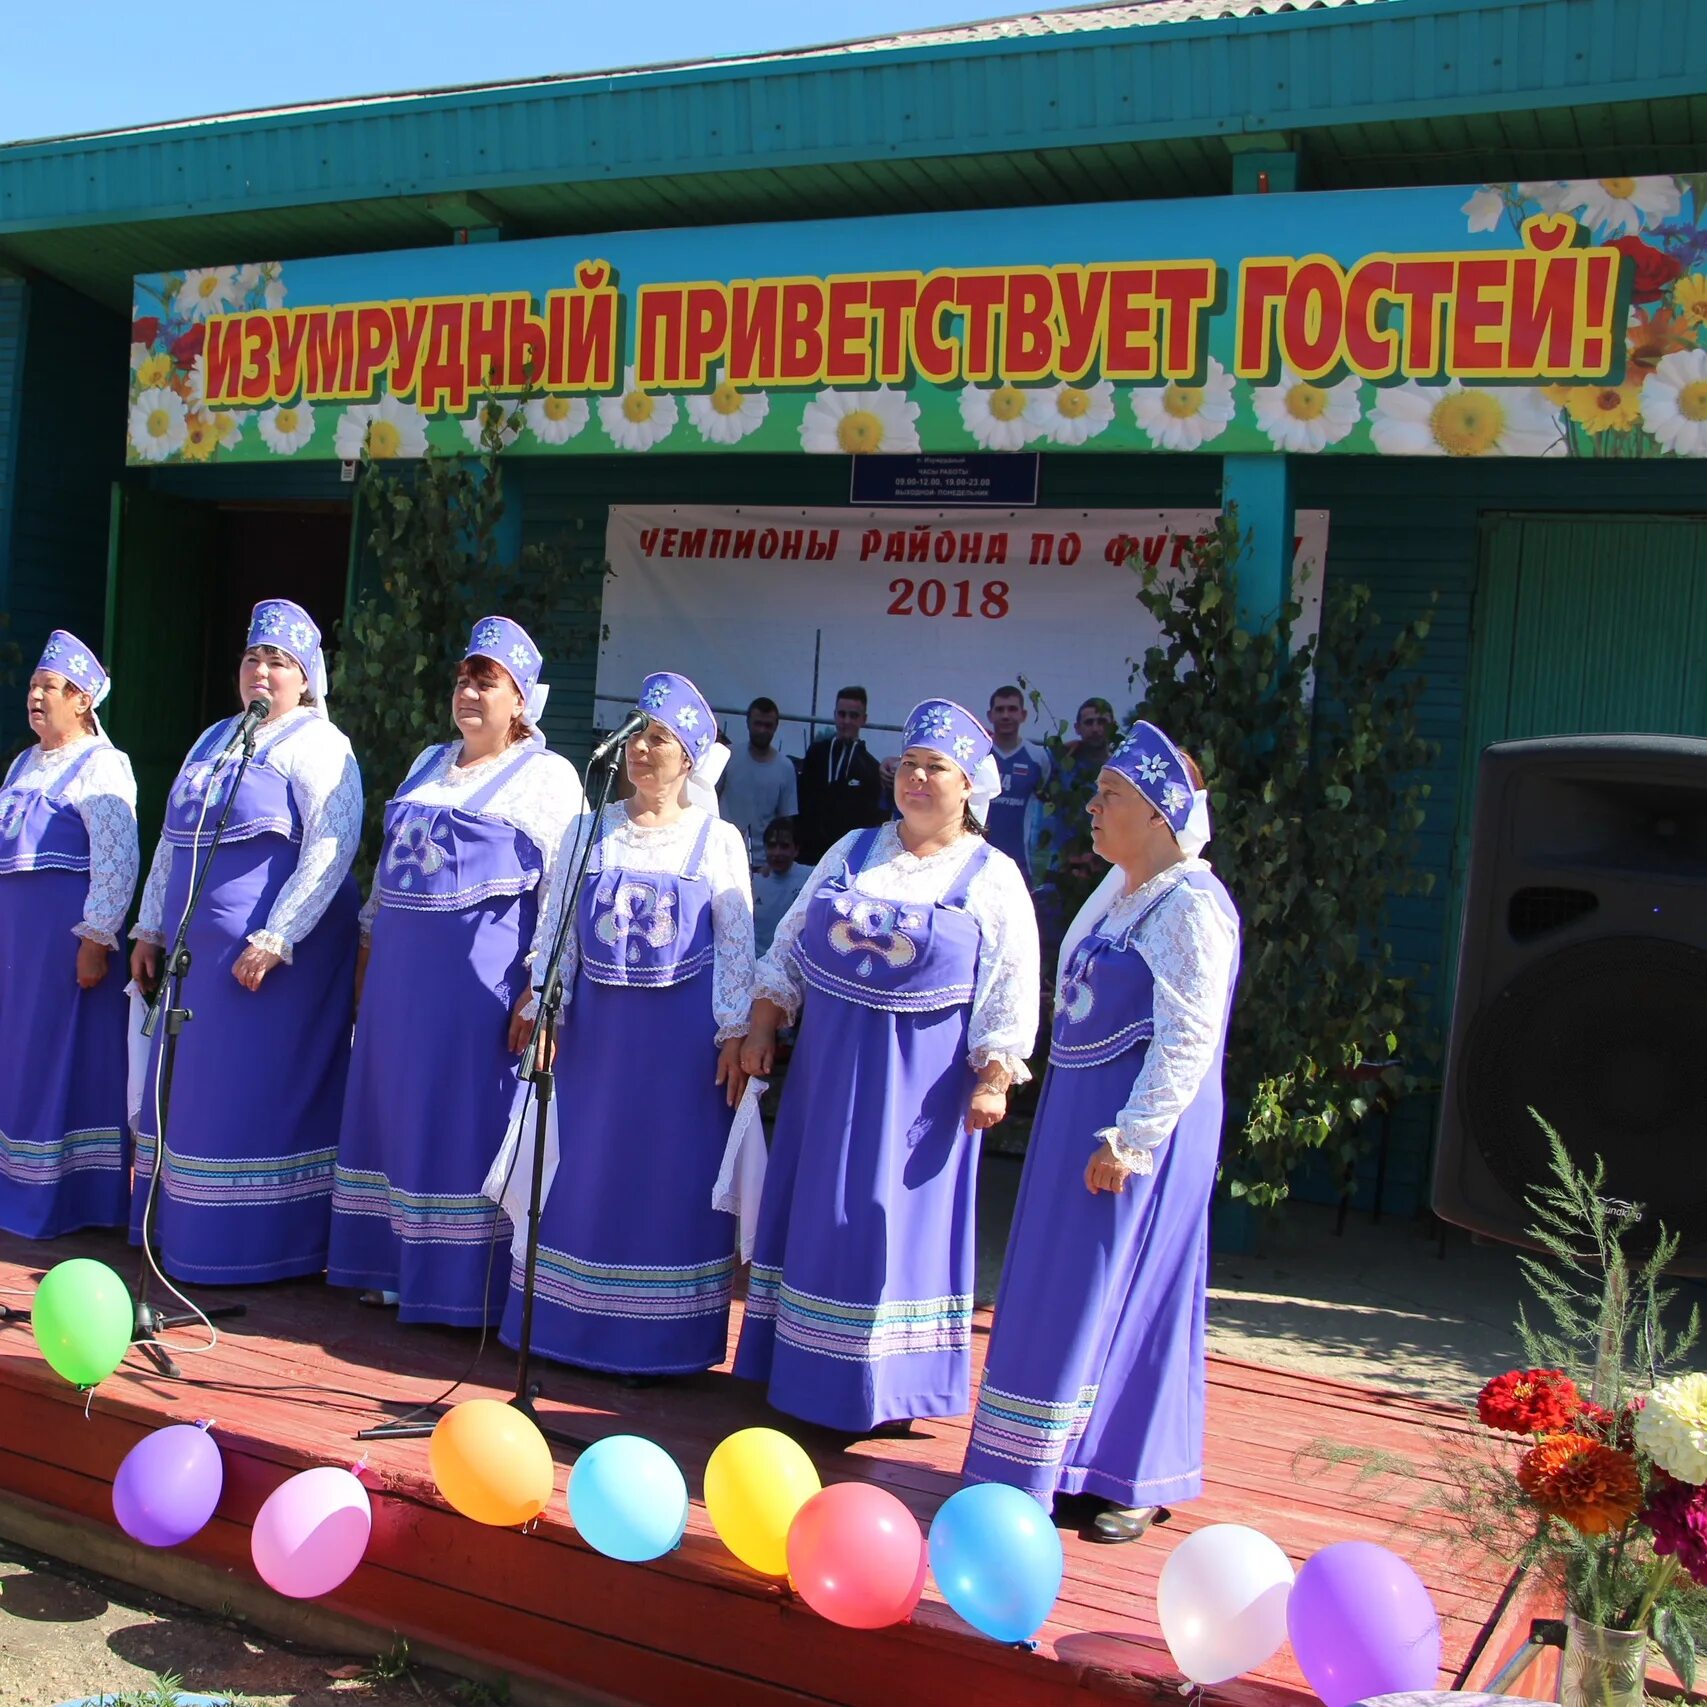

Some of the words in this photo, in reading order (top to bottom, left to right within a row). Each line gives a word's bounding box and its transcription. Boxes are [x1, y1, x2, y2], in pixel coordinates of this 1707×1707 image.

[204, 260, 617, 412] ИЗУМРУДНЫЙ
[636, 260, 1214, 385] ПРИВЕТСТВУЕТ
[1235, 215, 1618, 378] ГОСТЕЙ!
[918, 468, 939, 476] ЧАСЫ
[940, 468, 969, 476] РАБОТЫ
[937, 489, 989, 497] ПОНЕДЕЛЬНИК
[639, 527, 840, 561] ЧЕМПИОНЫ
[860, 524, 1009, 565] РАЙОНА
[1028, 531, 1082, 566] ПО
[886, 578, 1010, 619] 2018
